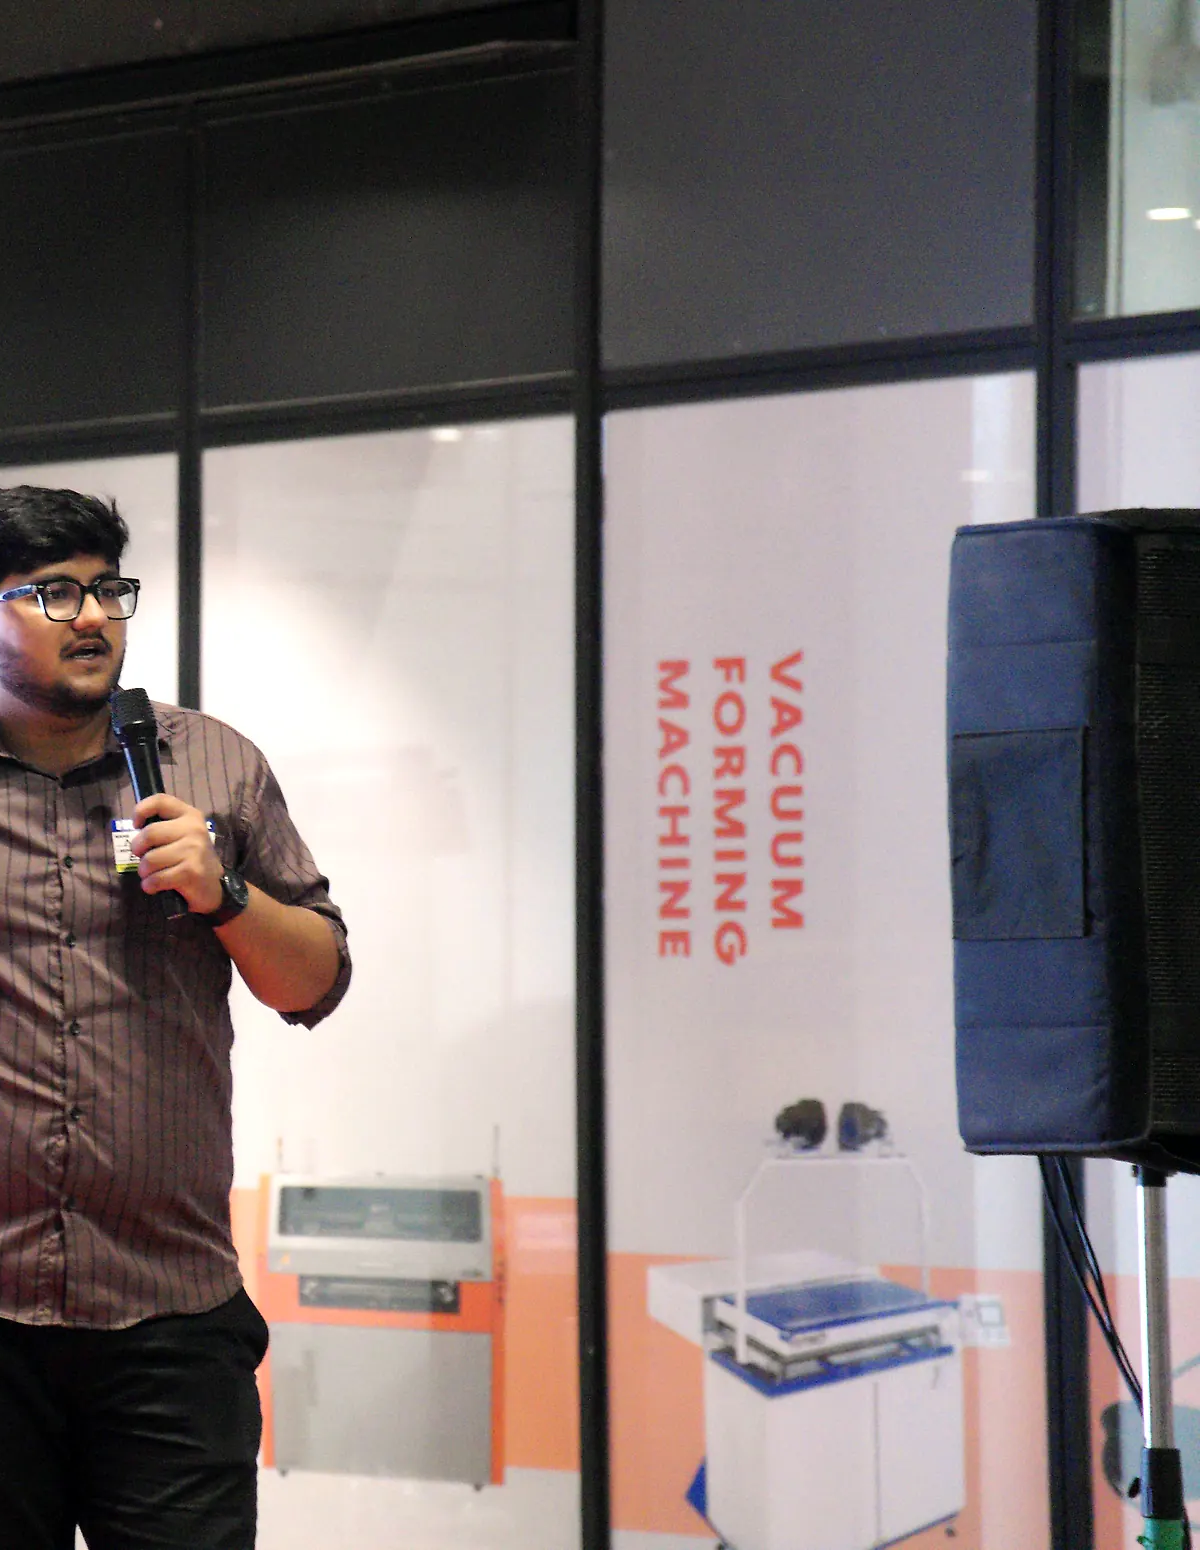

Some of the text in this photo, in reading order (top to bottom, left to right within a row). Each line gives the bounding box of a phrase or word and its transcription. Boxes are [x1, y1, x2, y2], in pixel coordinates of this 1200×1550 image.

[657, 659, 691, 958] MACHINE
[713, 656, 748, 966] FORMING
[769, 649, 804, 930] VACUUM
